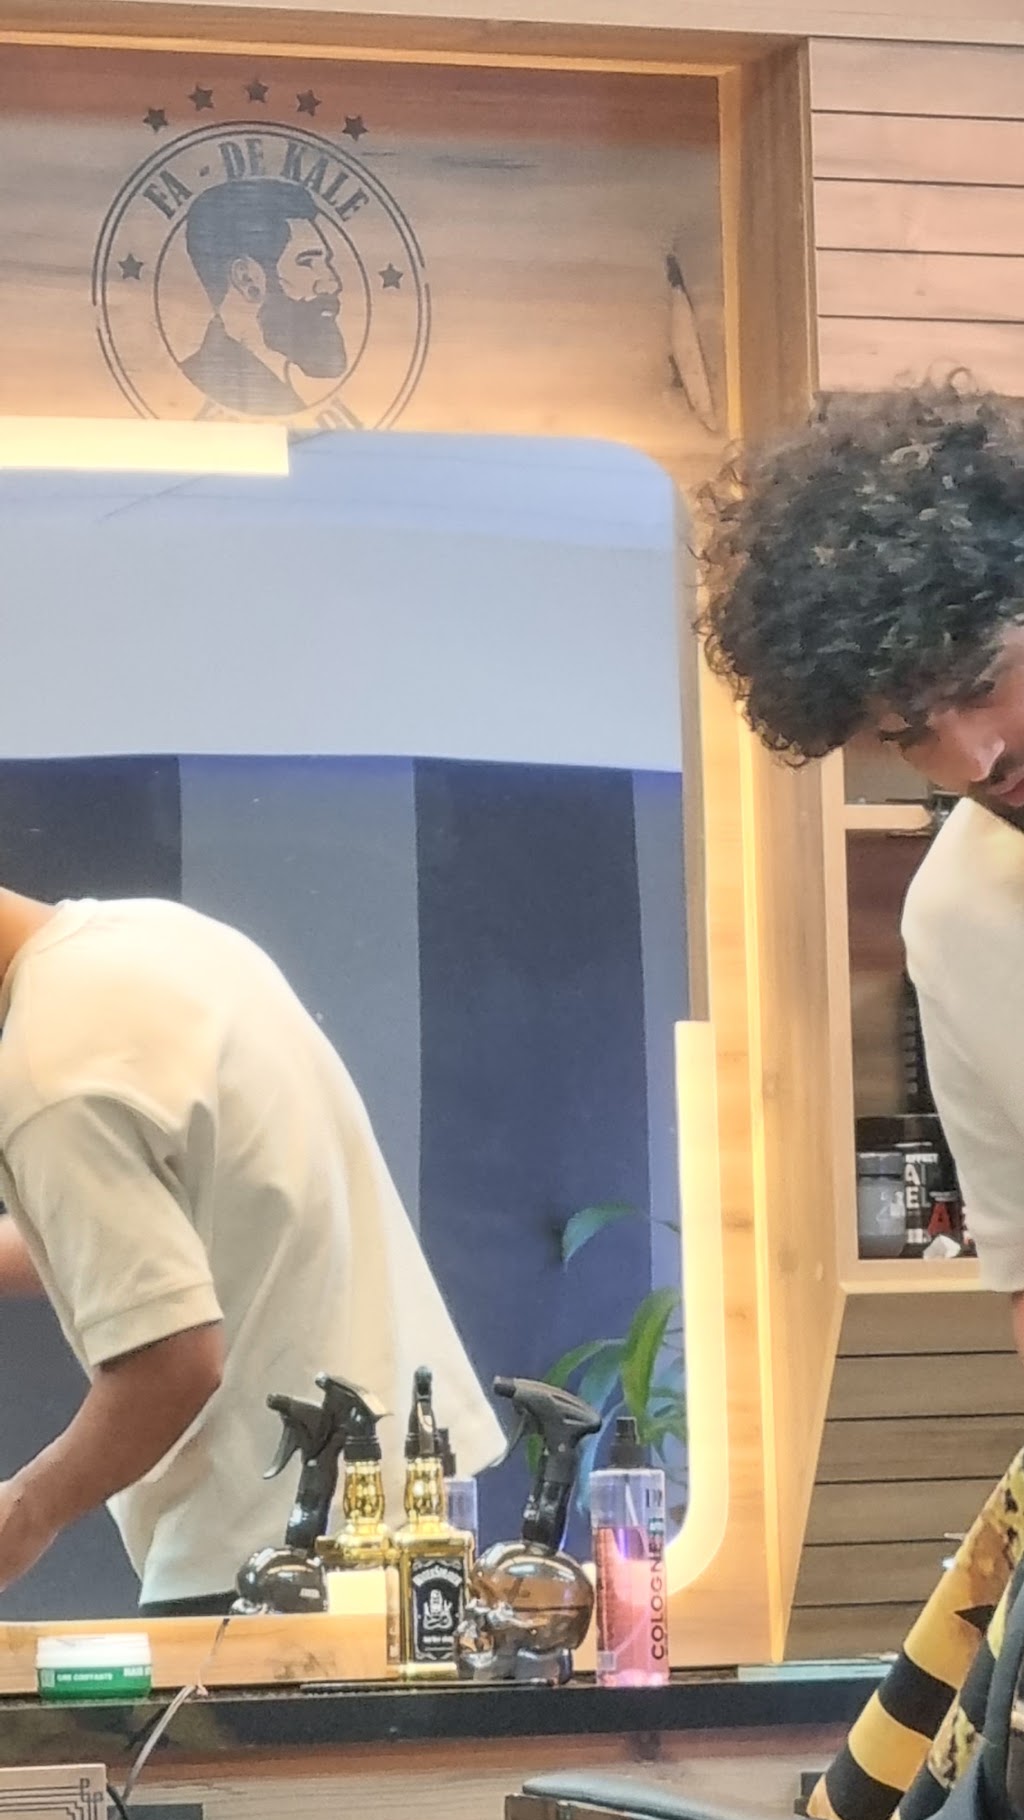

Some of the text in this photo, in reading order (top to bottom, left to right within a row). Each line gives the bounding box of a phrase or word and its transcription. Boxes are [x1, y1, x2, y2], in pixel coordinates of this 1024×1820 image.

[142, 167, 193, 221] FA
[218, 138, 265, 180] DE
[280, 141, 370, 222] KALE
